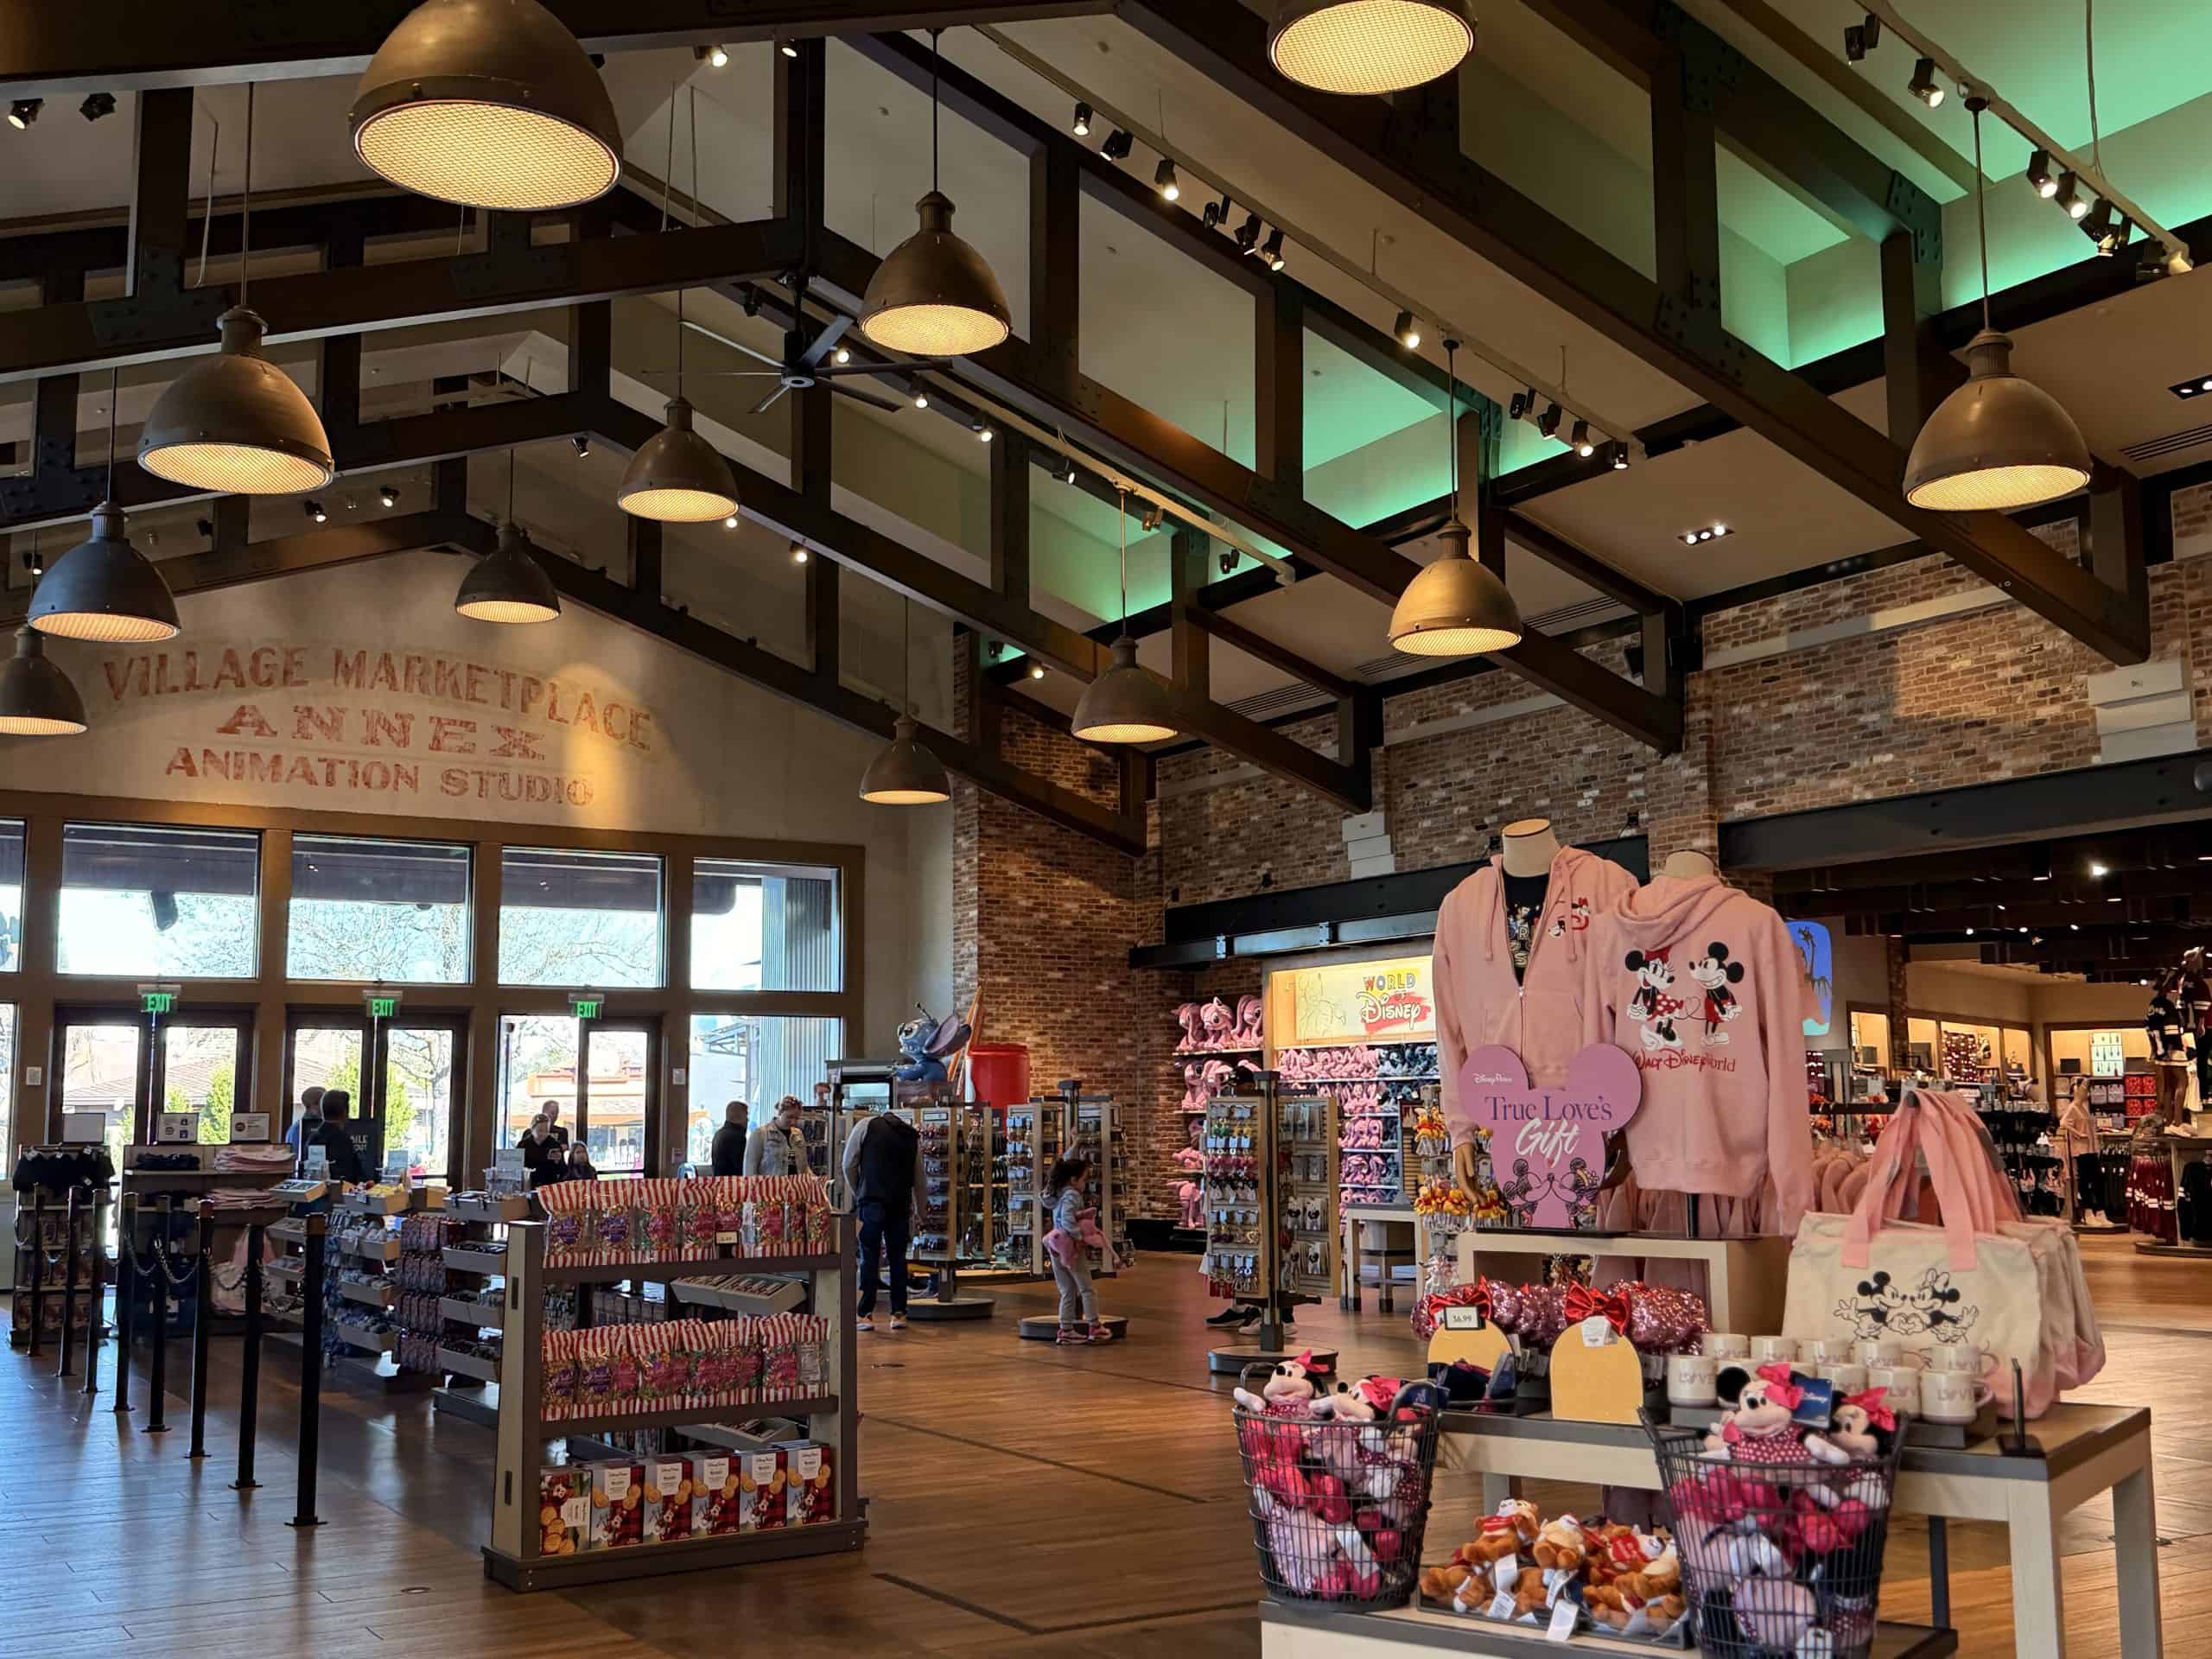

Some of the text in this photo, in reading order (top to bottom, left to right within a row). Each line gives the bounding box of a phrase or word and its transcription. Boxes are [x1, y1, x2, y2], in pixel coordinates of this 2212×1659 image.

[104, 648, 651, 750] VILLAGE MARKETPLACE
[217, 704, 545, 760] ANNEX
[166, 747, 594, 806] ANIMATION STUDIO
[1363, 973, 1416, 991] WORLD
[147, 994, 171, 1012] EXIT
[372, 999, 395, 1017] EXIT
[577, 1002, 597, 1018] EXIT
[1484, 1095, 1612, 1121] True Love's
[1515, 1117, 1580, 1169] Gift
